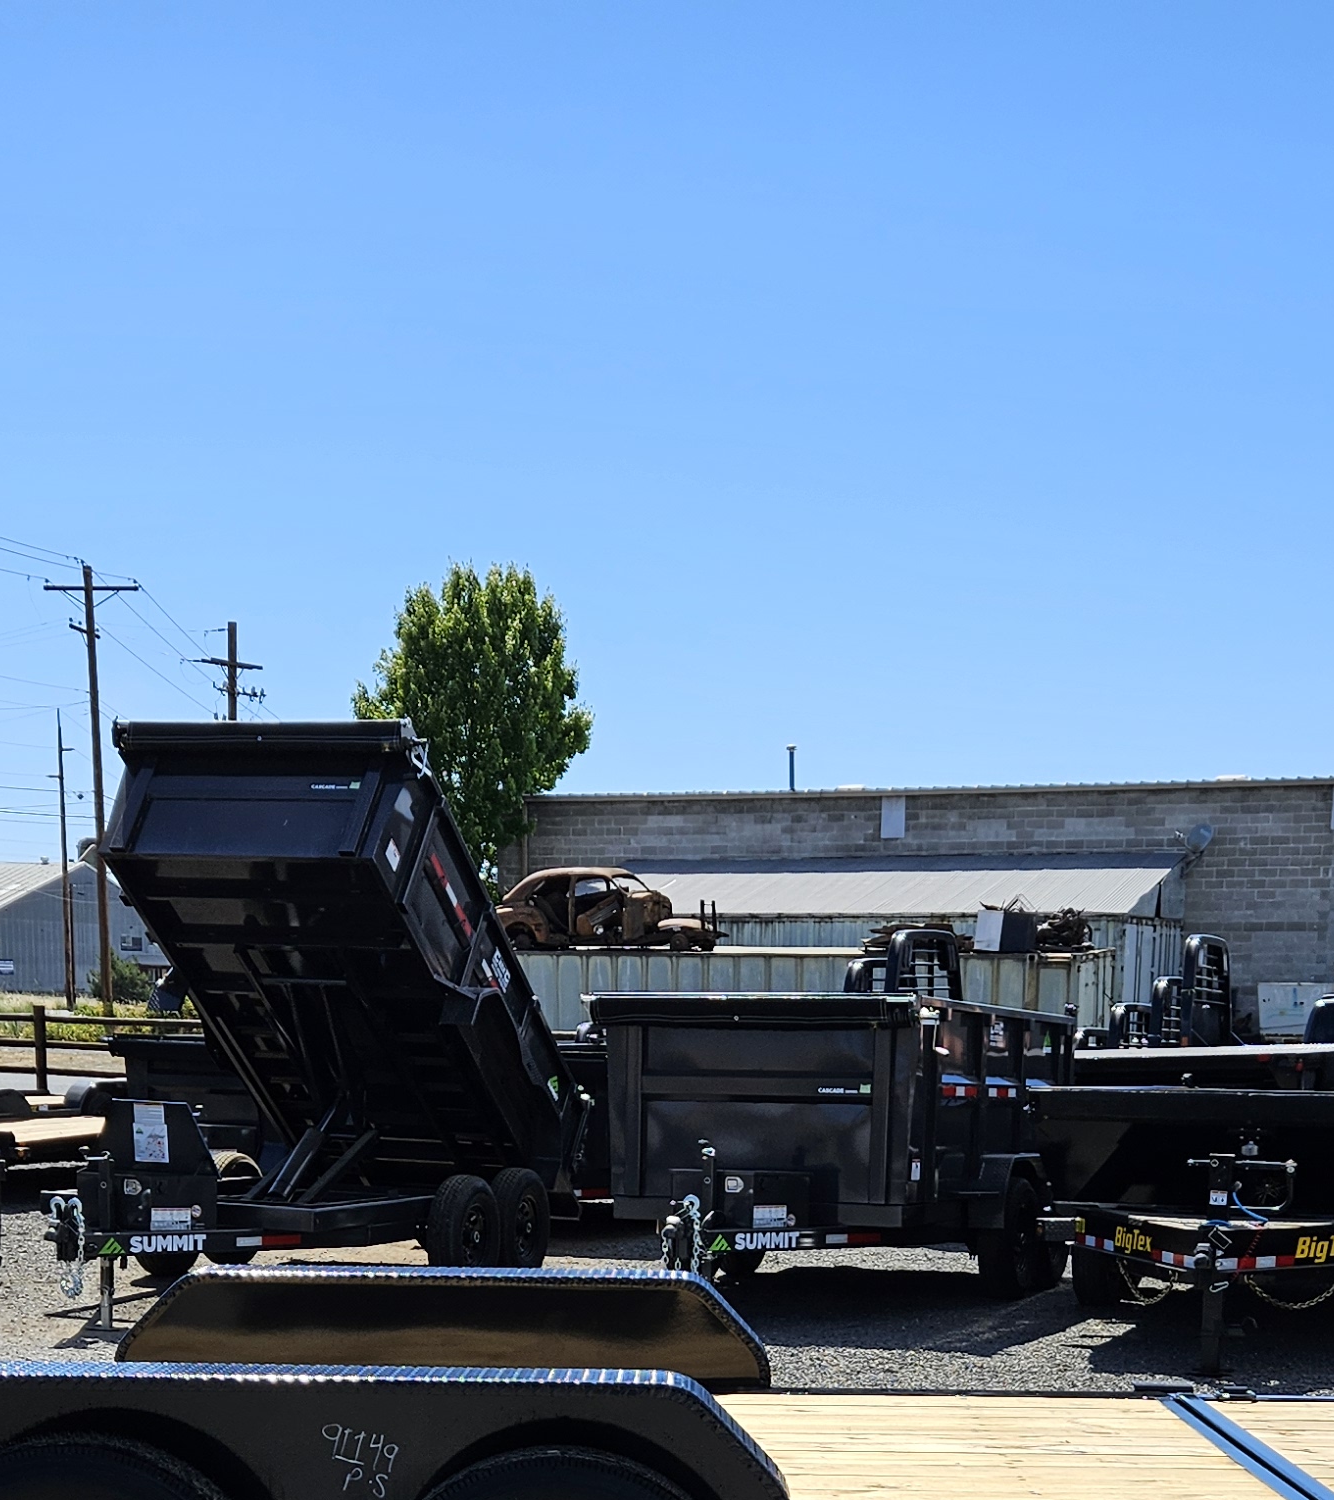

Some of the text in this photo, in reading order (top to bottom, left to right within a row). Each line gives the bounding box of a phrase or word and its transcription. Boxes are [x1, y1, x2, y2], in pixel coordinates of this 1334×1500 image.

[129, 1234, 207, 1253] SUMMIT
[734, 1231, 800, 1250] SUMMIT
[1114, 1226, 1153, 1254] BigTex
[321, 1423, 400, 1473] 91149
